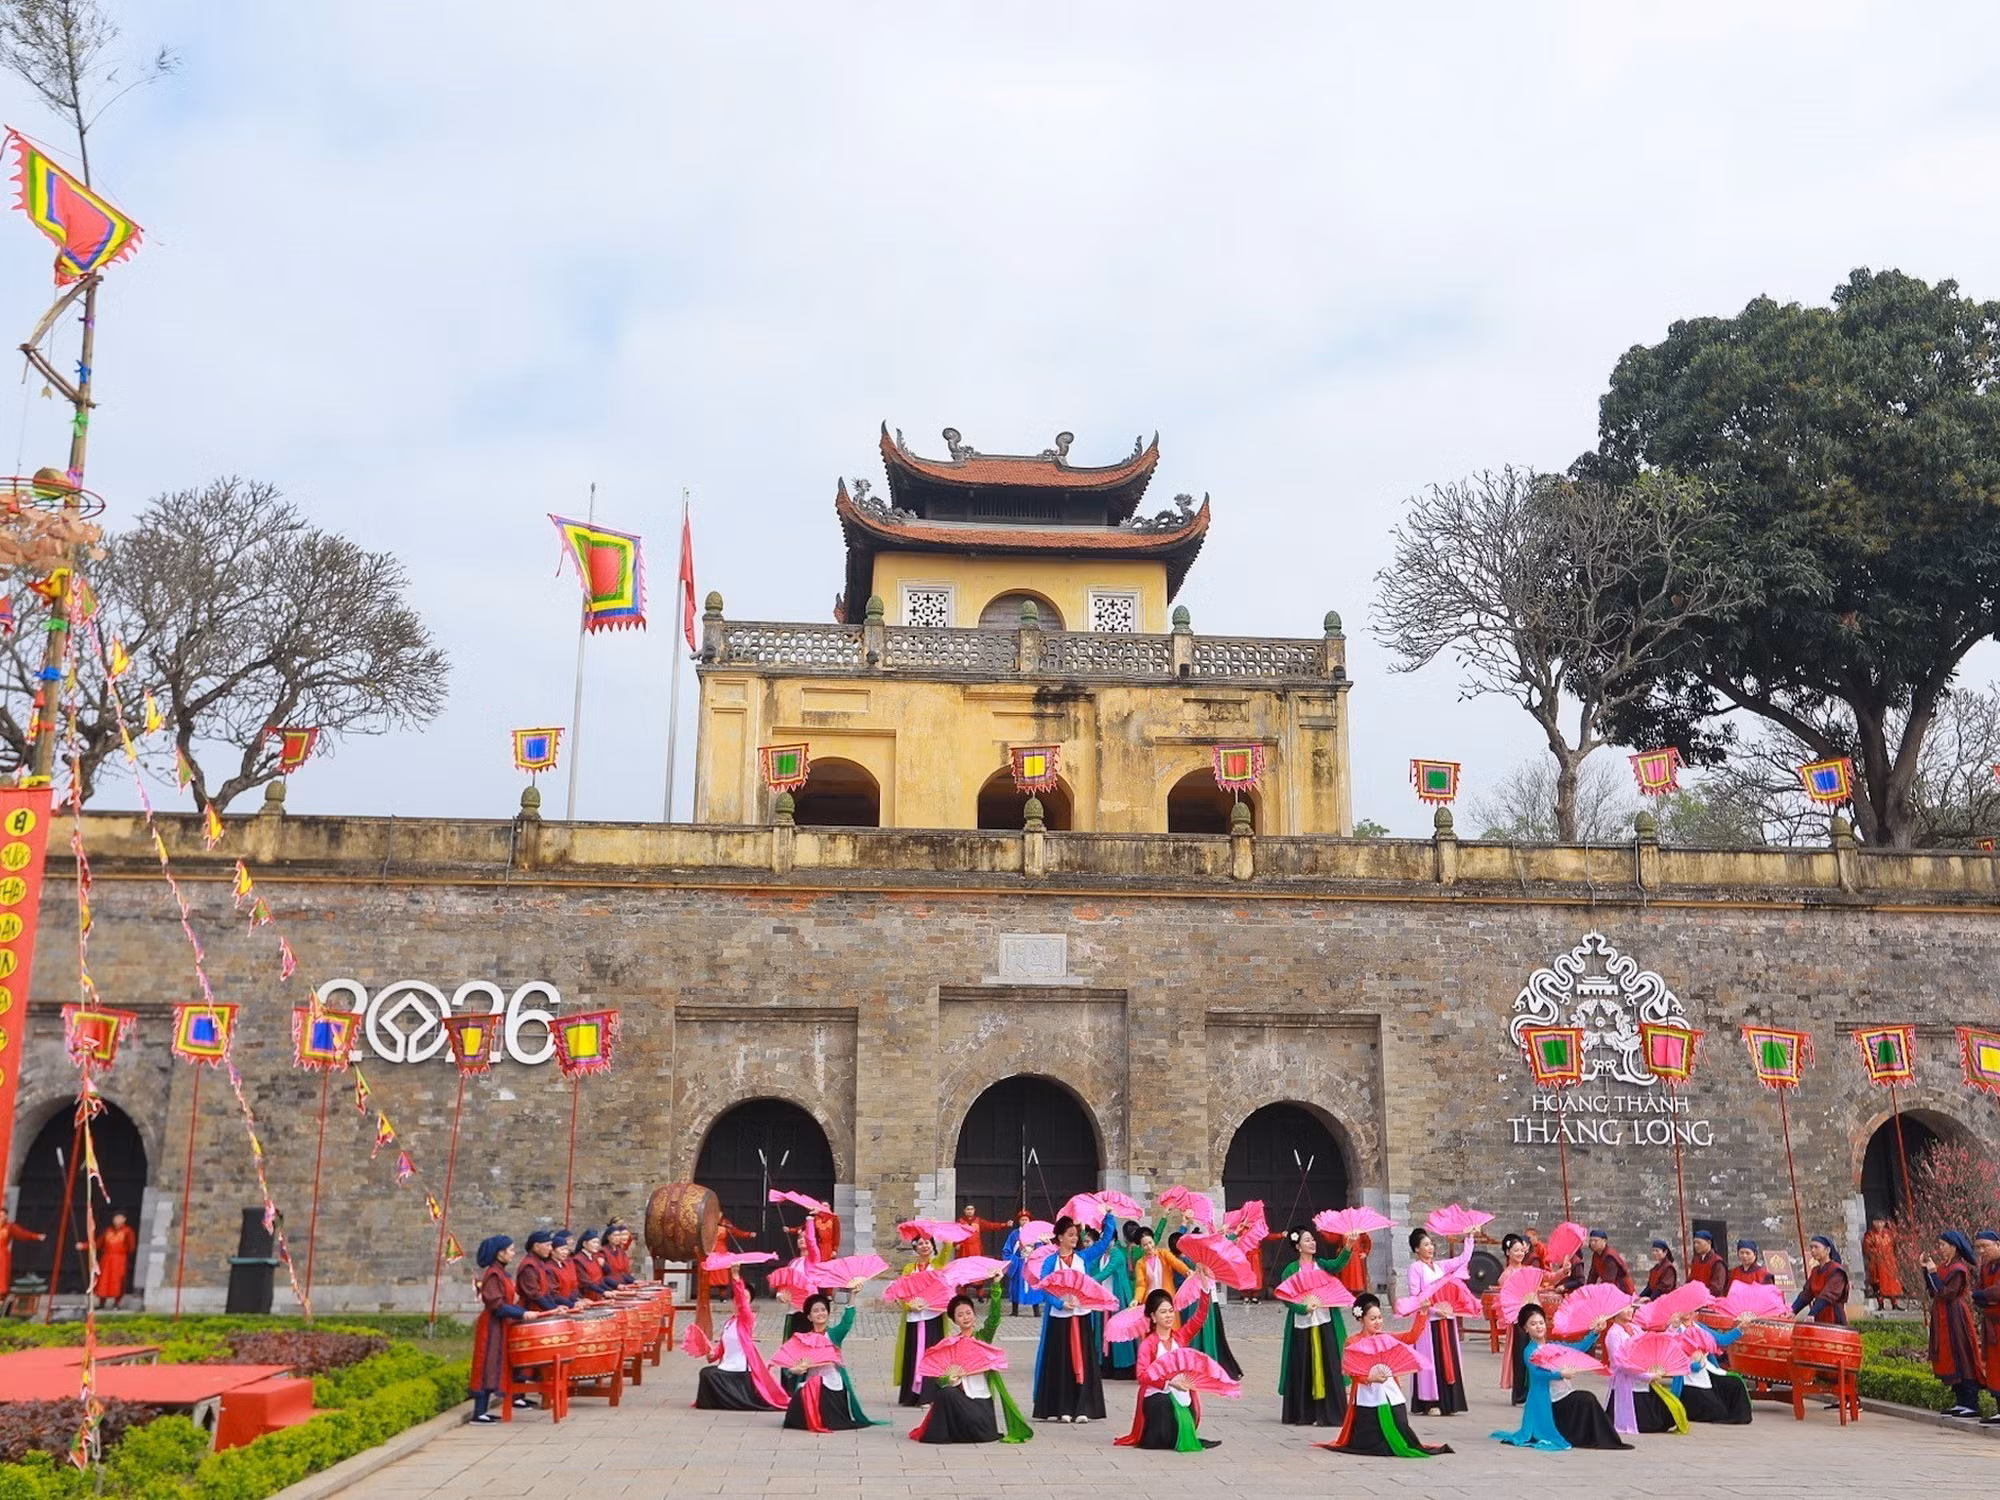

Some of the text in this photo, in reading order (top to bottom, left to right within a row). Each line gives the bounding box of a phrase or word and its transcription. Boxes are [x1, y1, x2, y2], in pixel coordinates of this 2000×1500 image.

[1532, 1092, 1690, 1114] HOÀNG THÀNH
[1507, 1113, 1715, 1147] THĂNG LONG
